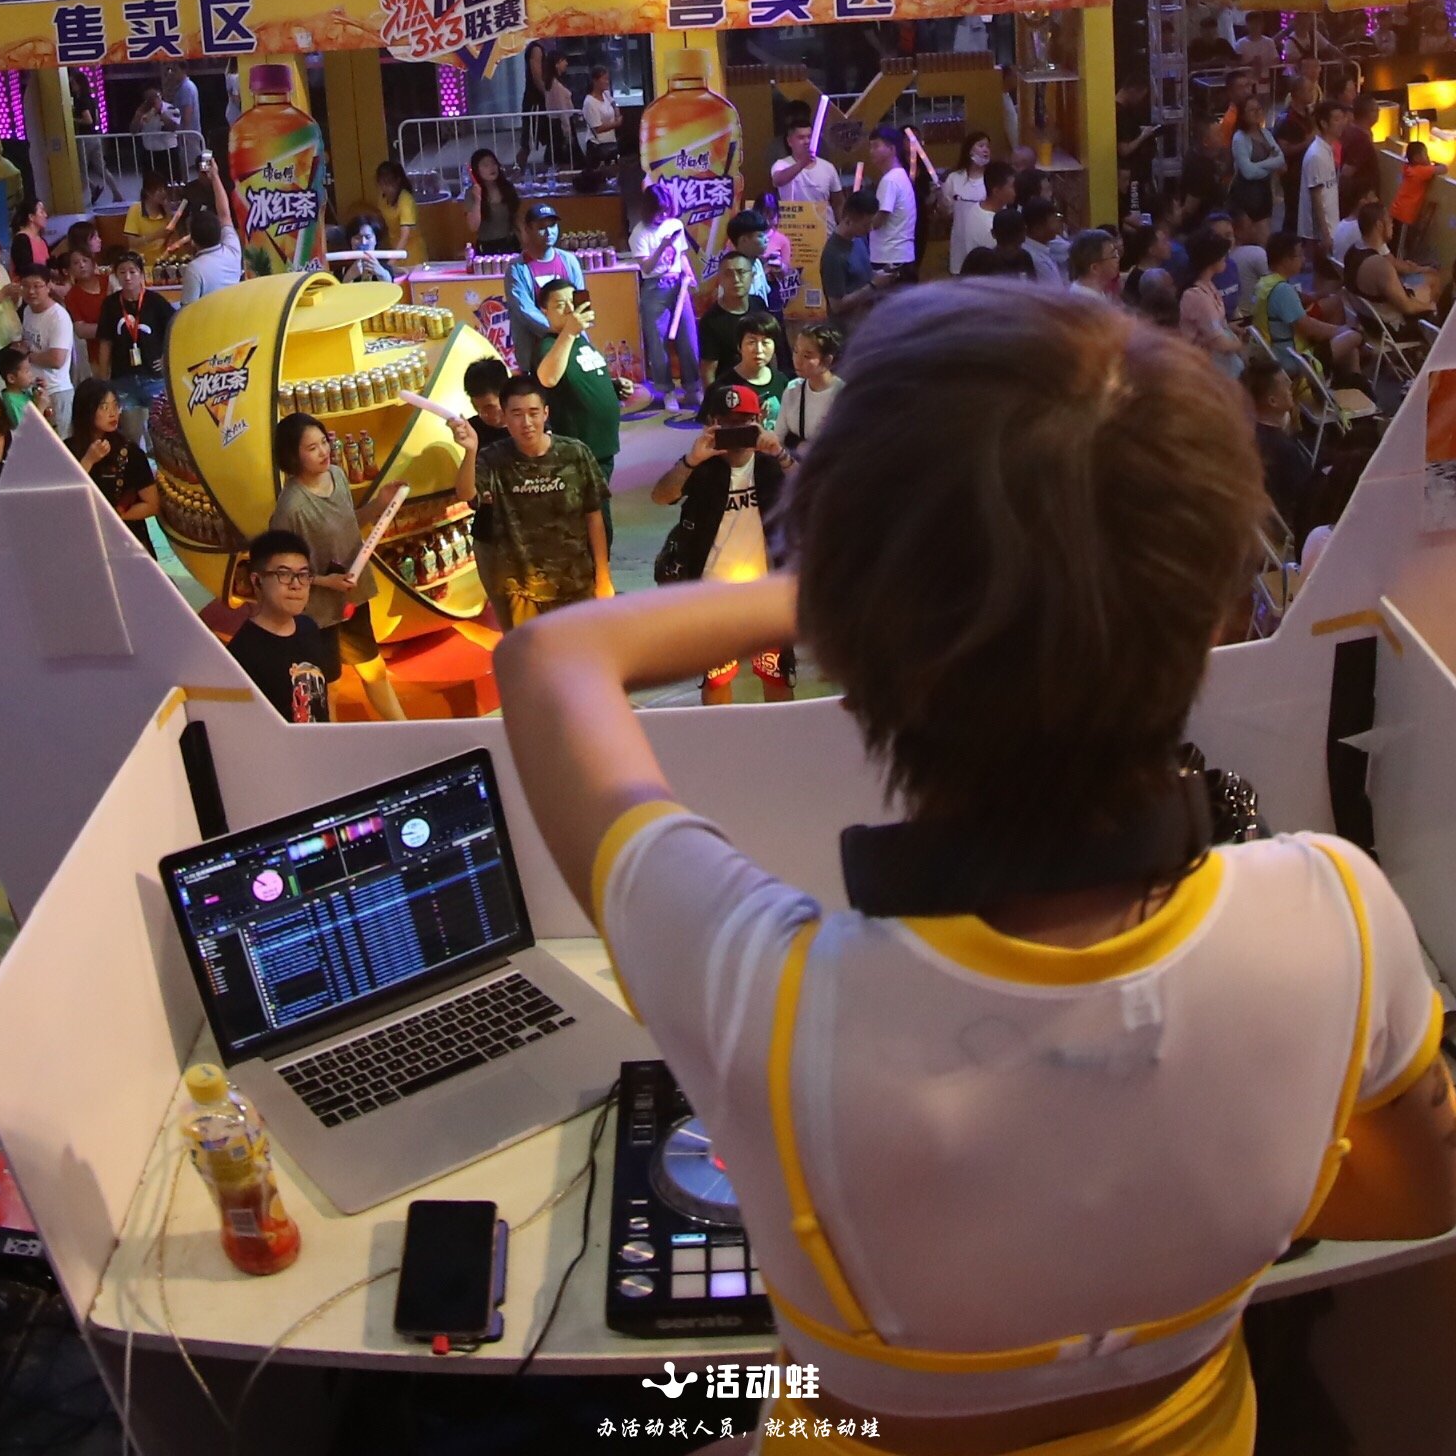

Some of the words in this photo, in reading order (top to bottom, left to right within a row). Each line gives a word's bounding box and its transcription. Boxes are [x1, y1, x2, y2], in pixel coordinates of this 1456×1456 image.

[246, 189, 317, 236] 冰红茶
[690, 210, 713, 223] ICE
[188, 369, 247, 411] 冰红茶
[726, 487, 759, 512] ANS
